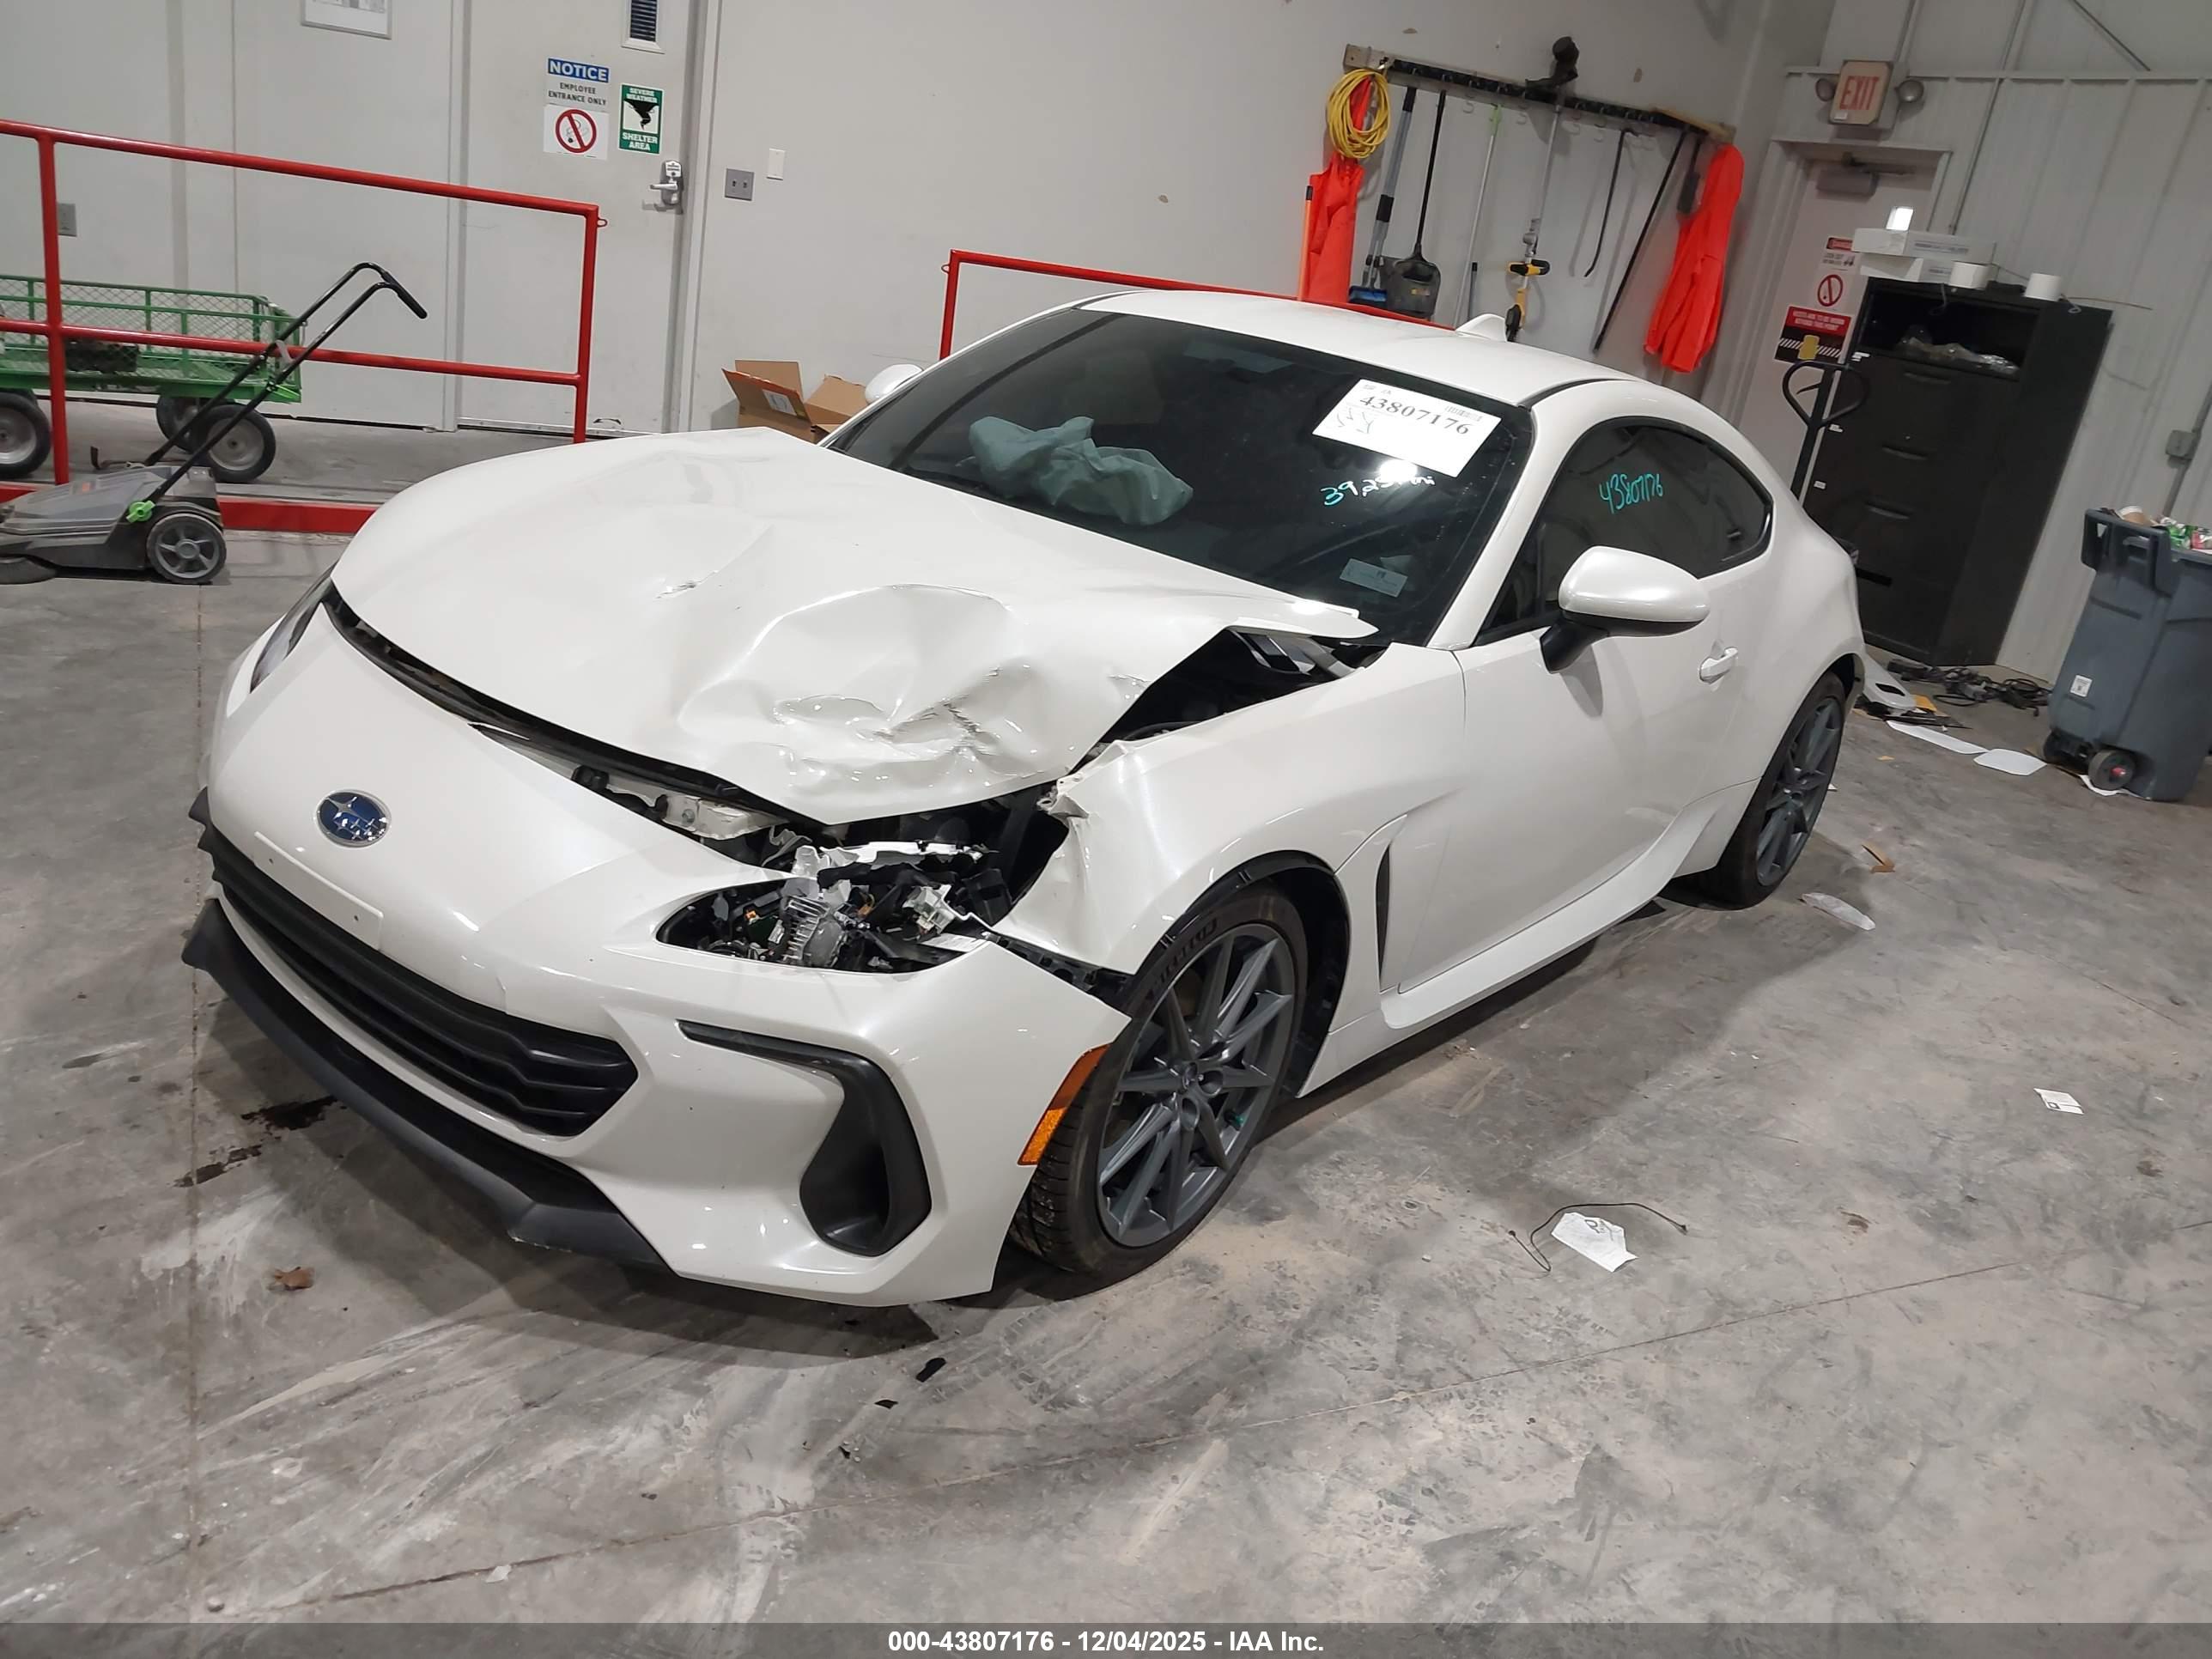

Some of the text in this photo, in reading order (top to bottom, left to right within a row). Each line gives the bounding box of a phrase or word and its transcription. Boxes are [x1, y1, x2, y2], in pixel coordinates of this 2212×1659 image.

[549, 60, 608, 82] NOTICE
[559, 82, 596, 94] EMPLOYEE
[1839, 76, 1880, 110] EXIT
[548, 90, 607, 106] ENTRANCE ONLY
[622, 131, 659, 144] SHELTER
[629, 142, 651, 151] AREA
[1359, 396, 1472, 434] 43807176
